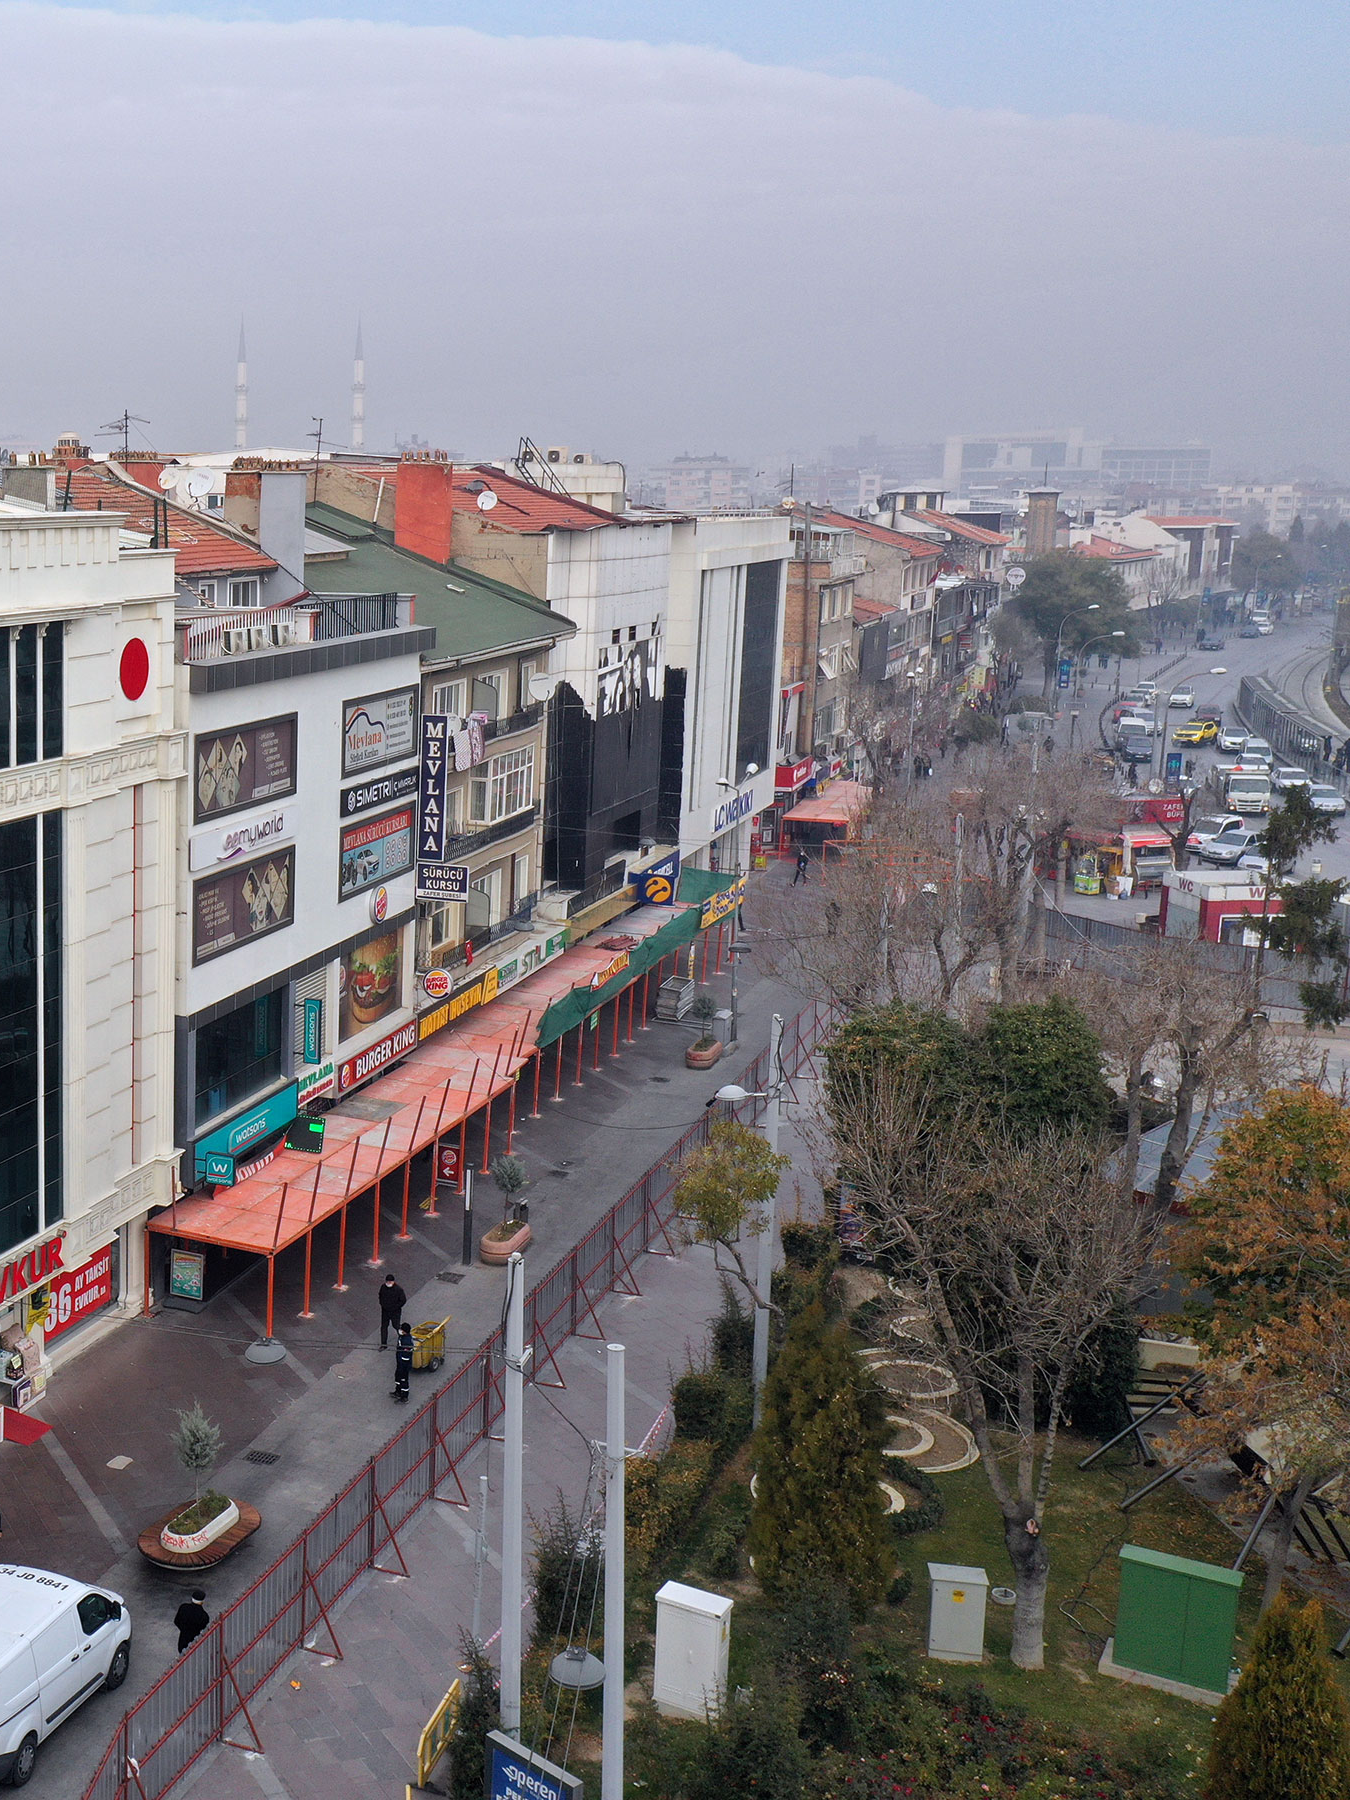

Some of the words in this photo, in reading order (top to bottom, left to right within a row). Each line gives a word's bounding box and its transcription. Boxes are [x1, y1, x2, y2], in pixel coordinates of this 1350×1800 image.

[348, 731, 382, 750] Mevlana
[424, 722, 444, 851] MEVLANA
[714, 805, 728, 832] LC
[423, 866, 463, 880] SÜRÜCÜ
[425, 879, 460, 891] KURSU
[1179, 878, 1193, 892] WC
[426, 982, 448, 990] KING
[356, 1039, 392, 1080] BURGER
[393, 1024, 415, 1054] KING
[236, 1117, 267, 1143] watsons
[44, 1283, 72, 1332] 36
[75, 1273, 84, 1292] AY
[16, 1571, 35, 1581] JD
[36, 1576, 70, 1591] 8841
